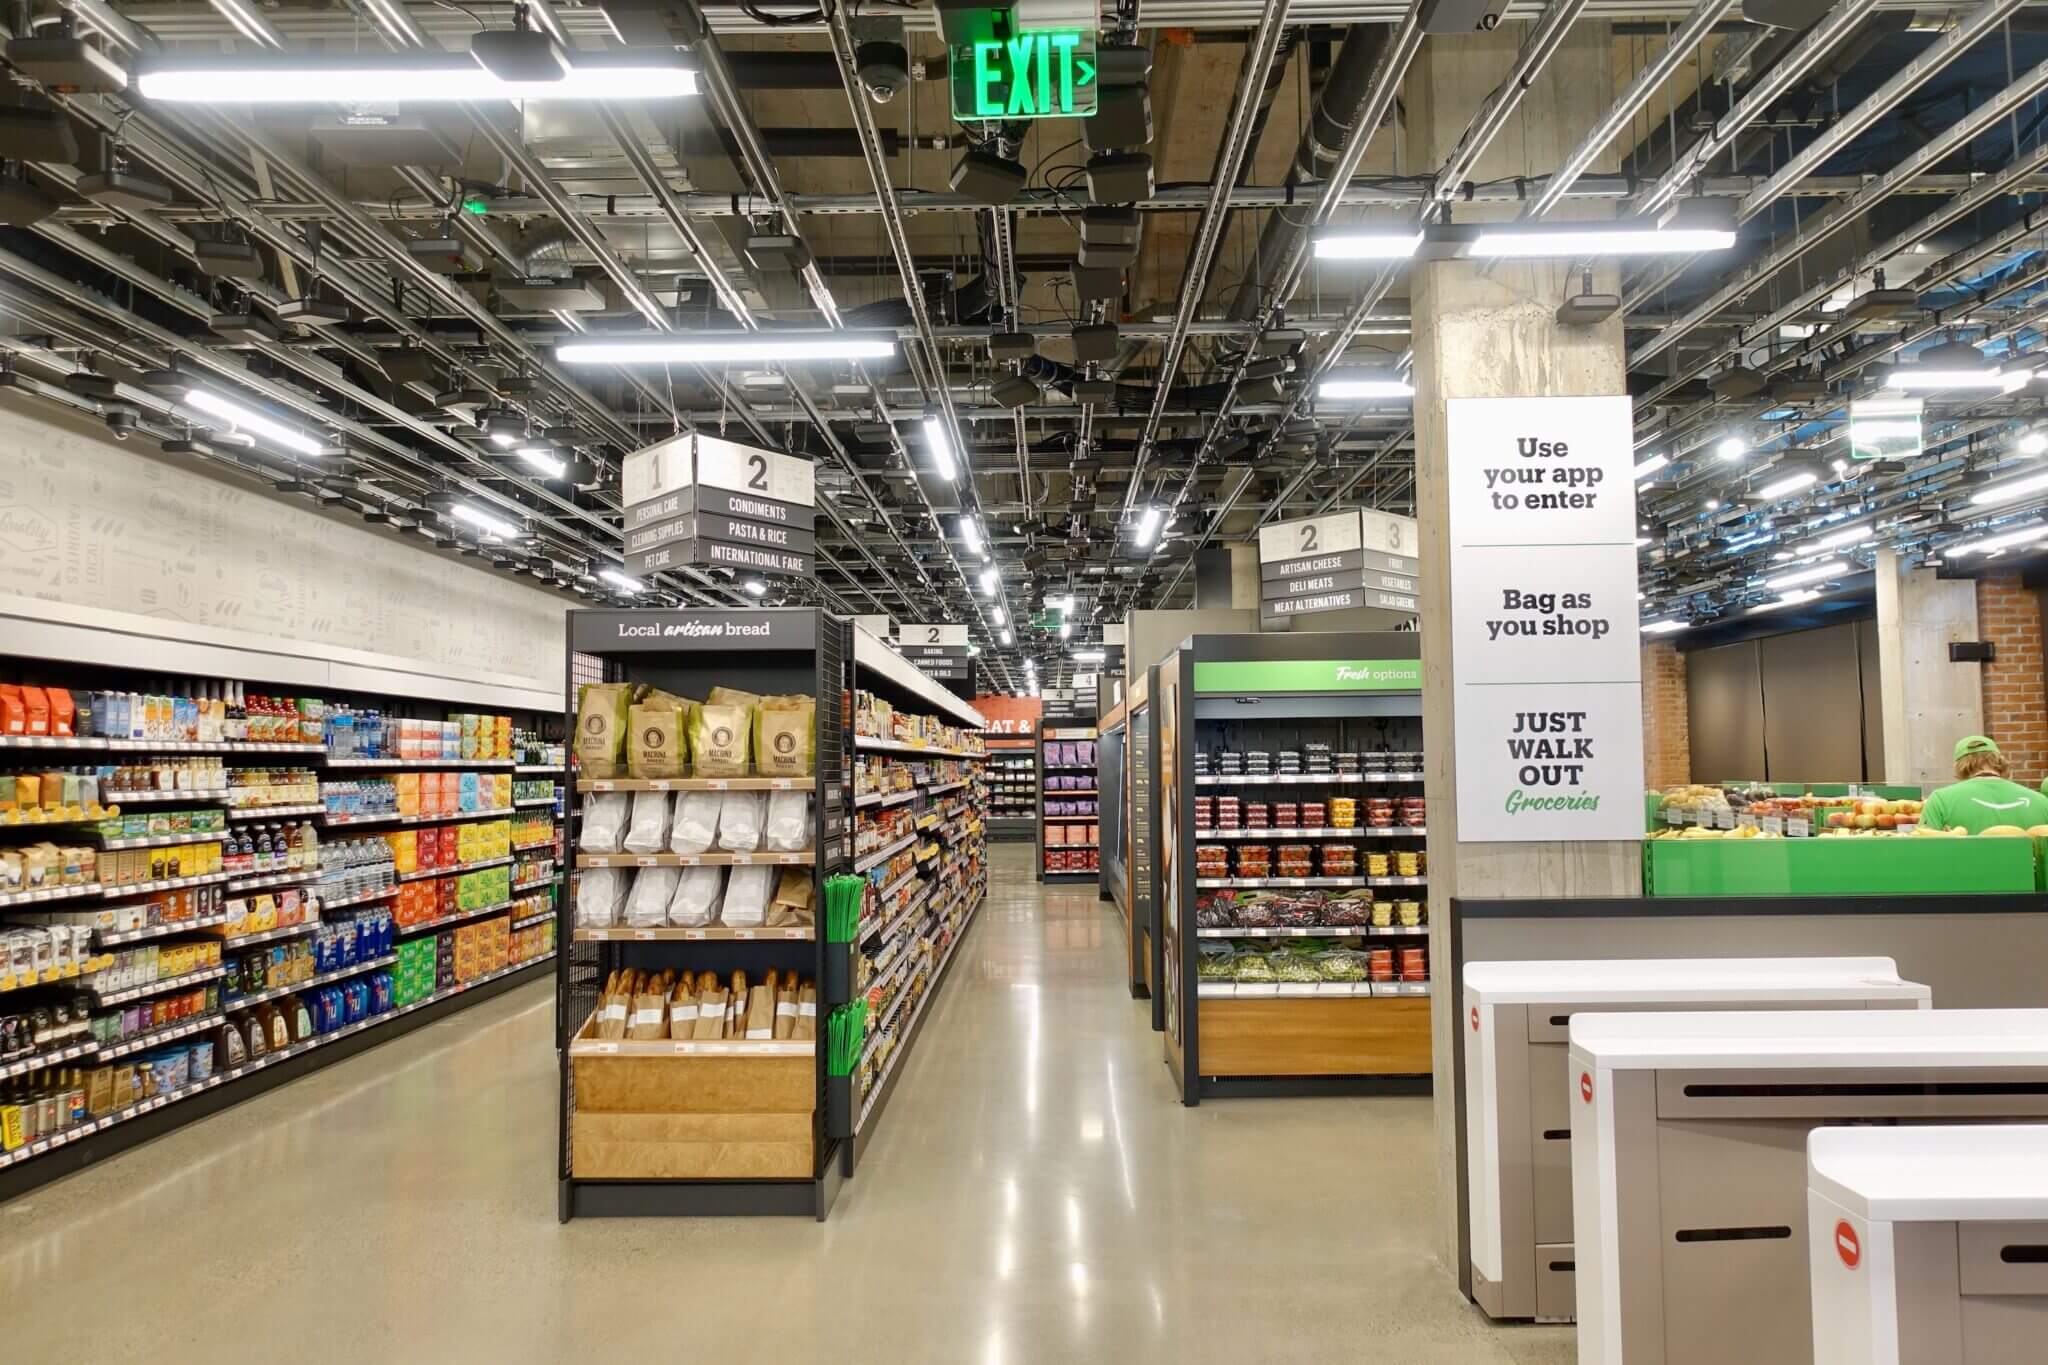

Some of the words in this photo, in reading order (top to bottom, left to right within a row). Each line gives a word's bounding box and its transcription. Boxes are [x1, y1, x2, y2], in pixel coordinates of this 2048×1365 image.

[974, 34, 1080, 115] EXIT
[1517, 437, 1569, 458] Use
[651, 454, 662, 490] 1
[748, 454, 769, 491] 2
[1483, 467, 1546, 488] your
[1552, 466, 1604, 488] app
[664, 496, 678, 512] CARE
[729, 497, 787, 521] CONDIMENTS
[1491, 491, 1519, 510] to
[1524, 490, 1597, 510] enter
[657, 521, 684, 541] SUPPLIES
[729, 523, 757, 539] PASTA
[759, 527, 766, 540] &
[767, 528, 788, 545] RICE
[1300, 524, 1318, 552] 2
[1389, 522, 1401, 550] 3
[644, 554, 655, 568] PET
[655, 550, 670, 566] CARE
[711, 545, 781, 568] INTERNATIONAL
[782, 555, 804, 572] FARE
[1280, 562, 1311, 576] ARTISAN
[1312, 556, 1343, 571] CHEESE
[1289, 581, 1307, 593] DELI
[1308, 577, 1334, 591] MEATS
[1274, 601, 1295, 613] MEAT
[1295, 594, 1351, 611] ALTERNATIVES
[1503, 589, 1556, 614] Bag
[1561, 592, 1592, 609] as
[619, 623, 660, 637] Local
[663, 620, 724, 638] artisan
[725, 621, 771, 636] bread
[927, 627, 940, 643] 2
[1486, 619, 1537, 641] you
[1542, 614, 1610, 640] shop
[1336, 666, 1371, 681] Fresh
[1373, 668, 1417, 681] options
[1018, 719, 1031, 734] &
[1512, 712, 1587, 733] JUST
[1507, 738, 1594, 759] WALK
[1518, 765, 1584, 786] OUT
[1504, 789, 1601, 816] Groceries
